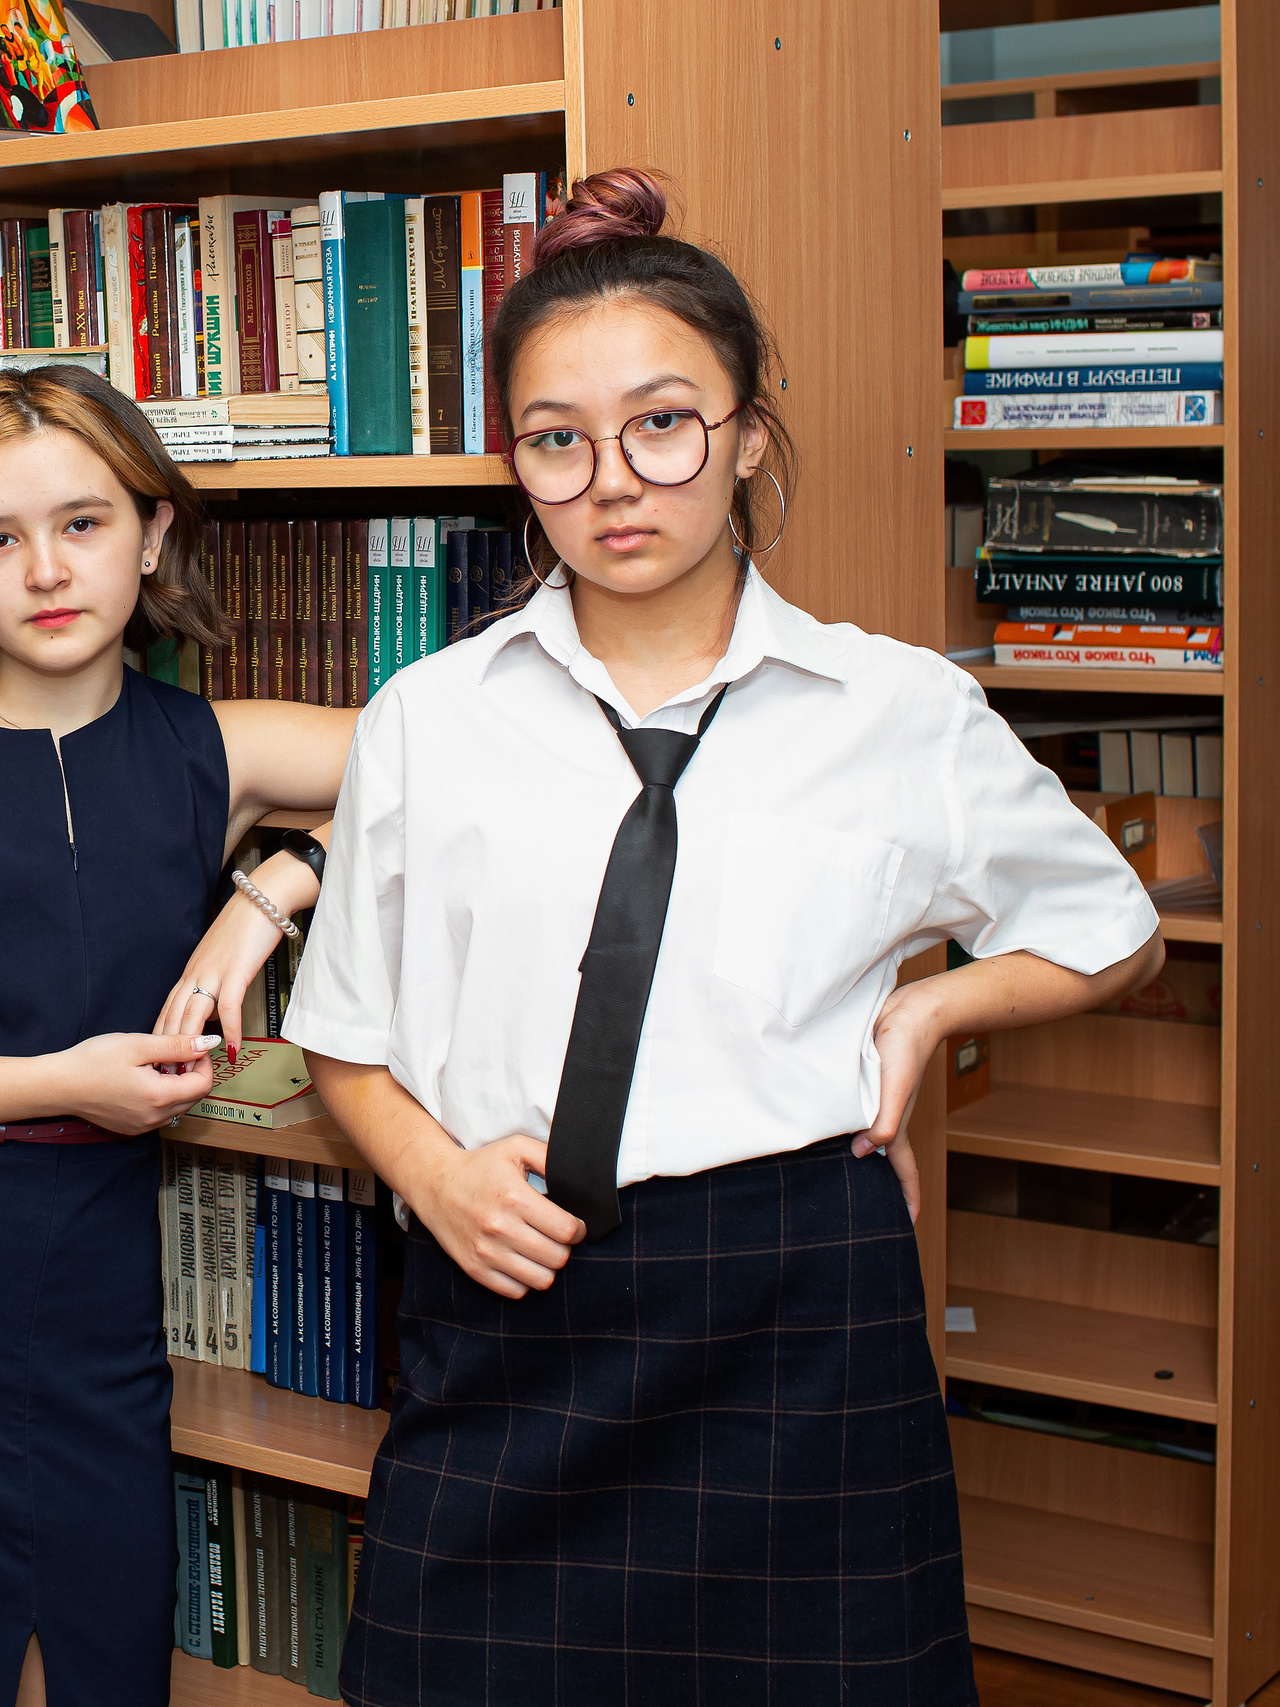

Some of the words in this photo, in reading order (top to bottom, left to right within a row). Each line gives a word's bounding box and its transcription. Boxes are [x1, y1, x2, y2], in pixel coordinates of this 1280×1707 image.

[205, 214, 219, 281] Рассказы
[149, 246, 157, 279] Пьесы
[325, 246, 333, 275] ПРОЗА
[245, 264, 254, 310] БУЛГАКОВ
[1035, 269, 1075, 284] БЛИЗКИЕ
[10, 281, 18, 307] Неточка
[76, 290, 84, 310] века
[326, 276, 335, 323] ИЗБРАННАЯ
[76, 312, 86, 330] XX
[151, 290, 160, 336] Рассказы
[247, 312, 254, 324] М.
[205, 294, 221, 364] ШУКШИН
[284, 302, 292, 350] РЕВИЗОР
[976, 319, 1028, 333] Животный
[1050, 318, 1089, 331] ИНДИИ
[328, 330, 336, 361] КУПРИН
[153, 353, 162, 394] Горький
[329, 362, 337, 371] И.
[329, 372, 337, 381] А.
[1082, 368, 1181, 386] ПЕТЕРБУРГ
[985, 371, 1063, 388] ГРАФИКЕ
[328, 556, 337, 593] Головлевы
[353, 553, 361, 590] Головлевы
[1074, 571, 1145, 593] JAHRE
[983, 573, 1068, 595] ANHALT
[1150, 574, 1183, 593] 800
[279, 592, 287, 620] Господа
[304, 593, 312, 620] Господа
[329, 594, 337, 622] Господа
[345, 588, 353, 619] История
[354, 591, 362, 619] Господа
[1019, 606, 1059, 620] такой
[1060, 607, 1084, 621] Кто
[1087, 607, 1128, 620] такое
[1129, 607, 1156, 622] Что
[373, 574, 381, 664] САЛТЫКОВ-ЩЕДРИН
[395, 574, 404, 664] САЛТЫКОВ-ЩЕДРИН
[1013, 650, 1054, 664] такой
[1056, 650, 1080, 664] Кто
[1084, 650, 1126, 662] такое
[1129, 651, 1155, 665] Что
[1191, 650, 1222, 665] Том
[325, 639, 334, 708] Салтыков-Щедрин
[350, 637, 359, 706] Салтыков-Щедрин
[373, 665, 380, 673] Е.
[373, 675, 380, 686] М.
[200, 1102, 235, 1118] ШОЛОХОВ
[235, 1108, 245, 1119] М.
[177, 1152, 193, 1206] КОРПУС
[198, 1155, 214, 1209] КОРПУС
[217, 1160, 235, 1199] ГУЛАГ
[271, 1215, 278, 1227] ПО
[296, 1222, 303, 1234] ПО
[354, 1209, 362, 1229] ЛЖИ
[219, 1204, 238, 1280] АРХИПЕЛАГ
[271, 1228, 278, 1239] НЕ
[296, 1235, 303, 1246] НЕ
[323, 1225, 330, 1238] ПО
[355, 1230, 362, 1243] ПО
[178, 1211, 196, 1279] РАКОВЫЙ
[201, 1215, 217, 1282] РАКОВЫЙ
[271, 1240, 279, 1262] ЖИТЬ
[323, 1239, 330, 1250] НЕ
[355, 1244, 362, 1256] НЕ
[296, 1247, 304, 1269] ЖИТЬ
[323, 1251, 331, 1273] ЖИТЬ
[211, 1478, 219, 1526] КРАВЧИНСКИЙ
[207, 1514, 213, 1522] С.
[185, 1498, 201, 1636] СТЕПНЯК-КРАВЧИНСКИЙ
[208, 1542, 223, 1586] КОЖУХОВ
[256, 1548, 265, 1595] ИЗБРАННЫЕ
[289, 1557, 297, 1605] ИЗБРАННЫЕ
[314, 1565, 324, 1630] СТАДНЮК
[210, 1590, 226, 1634] АНДРЕЙ
[257, 1596, 267, 1657] ПРОИЗВЕДЕНИЯ
[290, 1606, 298, 1668] ПРОИЗВЕДЕНИЯ
[188, 1637, 201, 1648] С.
[314, 1633, 324, 1669] ИВАН
